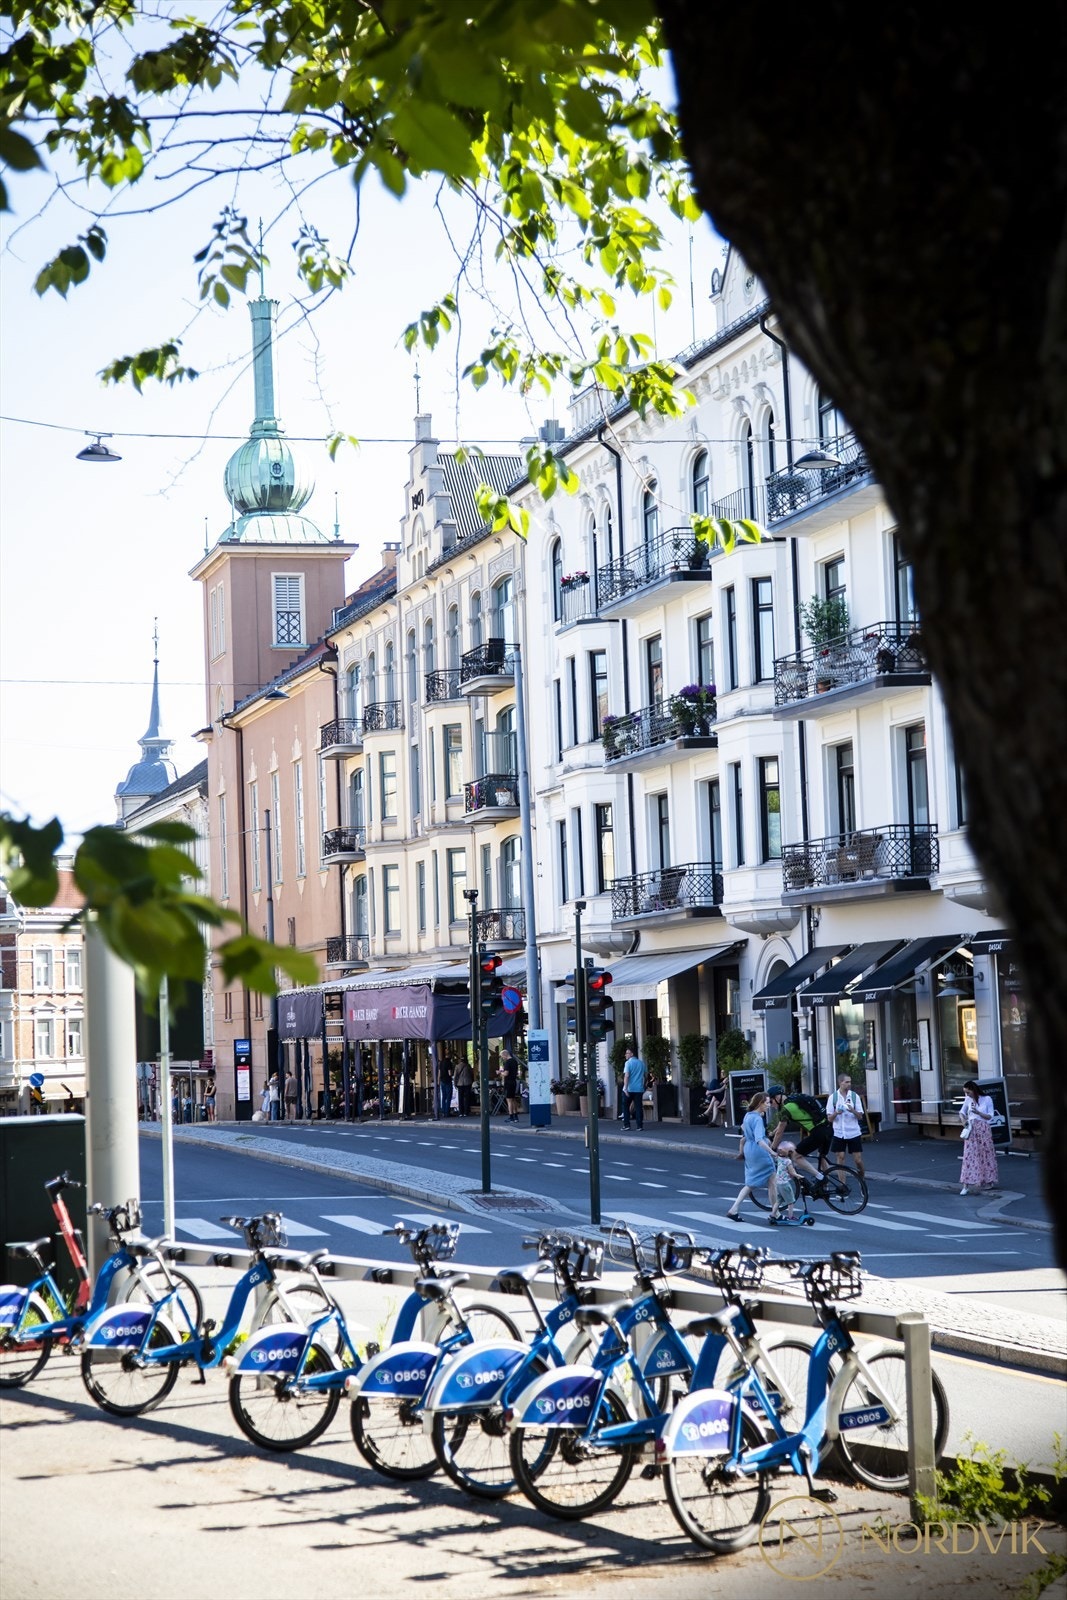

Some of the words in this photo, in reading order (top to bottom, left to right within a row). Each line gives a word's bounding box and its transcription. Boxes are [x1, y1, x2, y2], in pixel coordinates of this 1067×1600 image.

[116, 1325, 143, 1337] OBOS
[268, 1347, 299, 1361] OBOS
[656, 1360, 676, 1369] OBOS
[394, 1369, 427, 1383] OBOS
[474, 1369, 506, 1385] OBOS
[556, 1395, 591, 1411] OBOS
[857, 1412, 881, 1425] OBOS
[699, 1417, 730, 1437] OBOS
